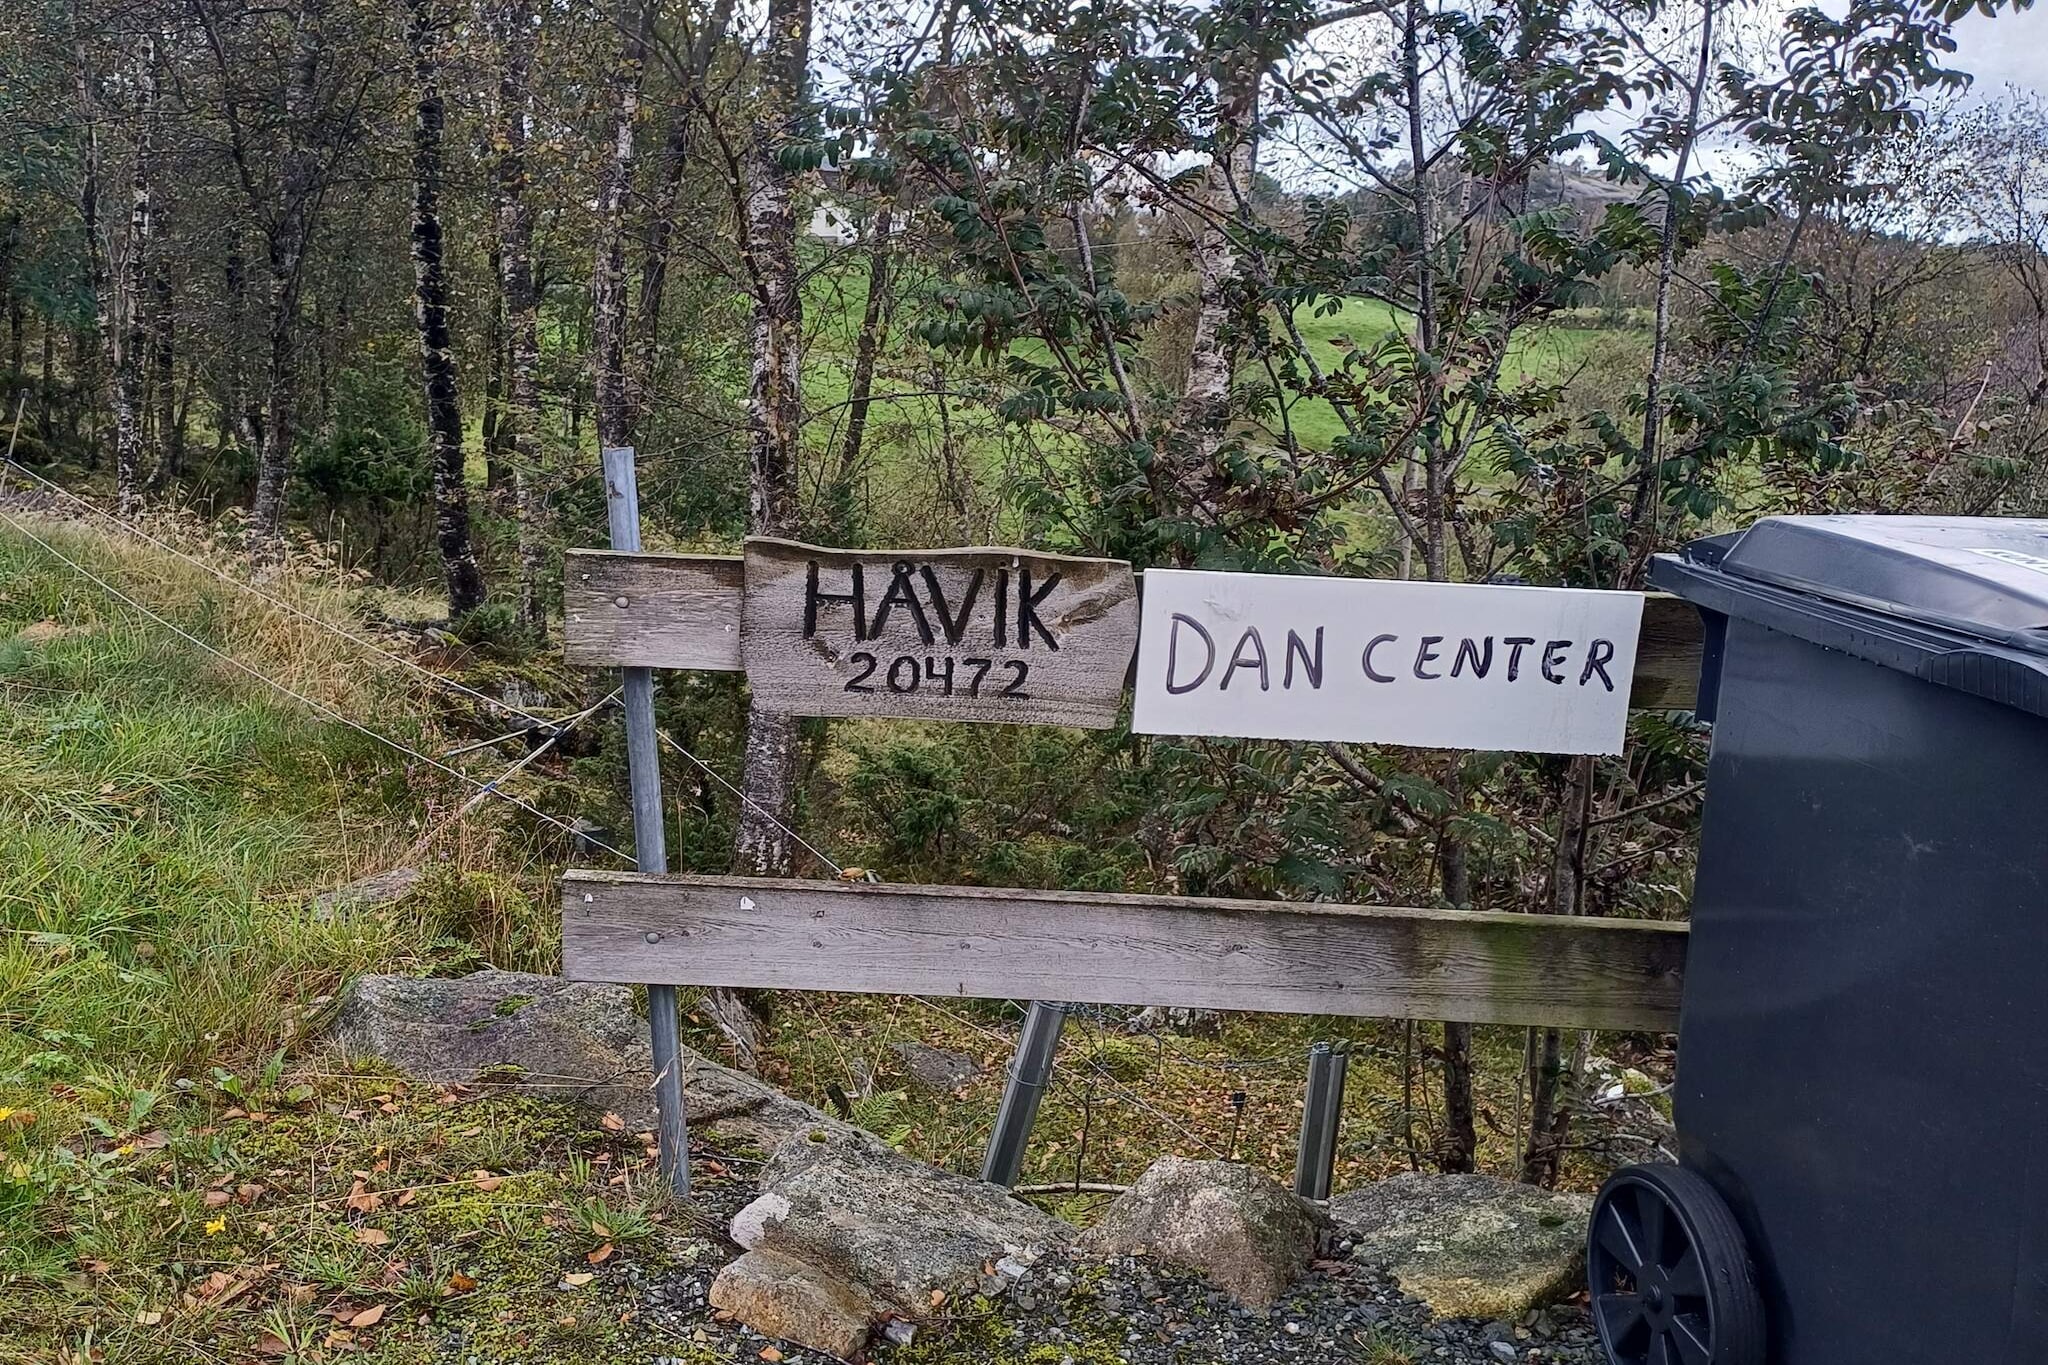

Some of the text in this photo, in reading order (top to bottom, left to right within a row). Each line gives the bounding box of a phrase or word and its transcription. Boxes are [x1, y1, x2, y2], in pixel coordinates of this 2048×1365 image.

[803, 560, 1061, 651] HÅVIK
[844, 652, 1030, 700] 20472
[1166, 612, 1616, 695] DAN CENTER
